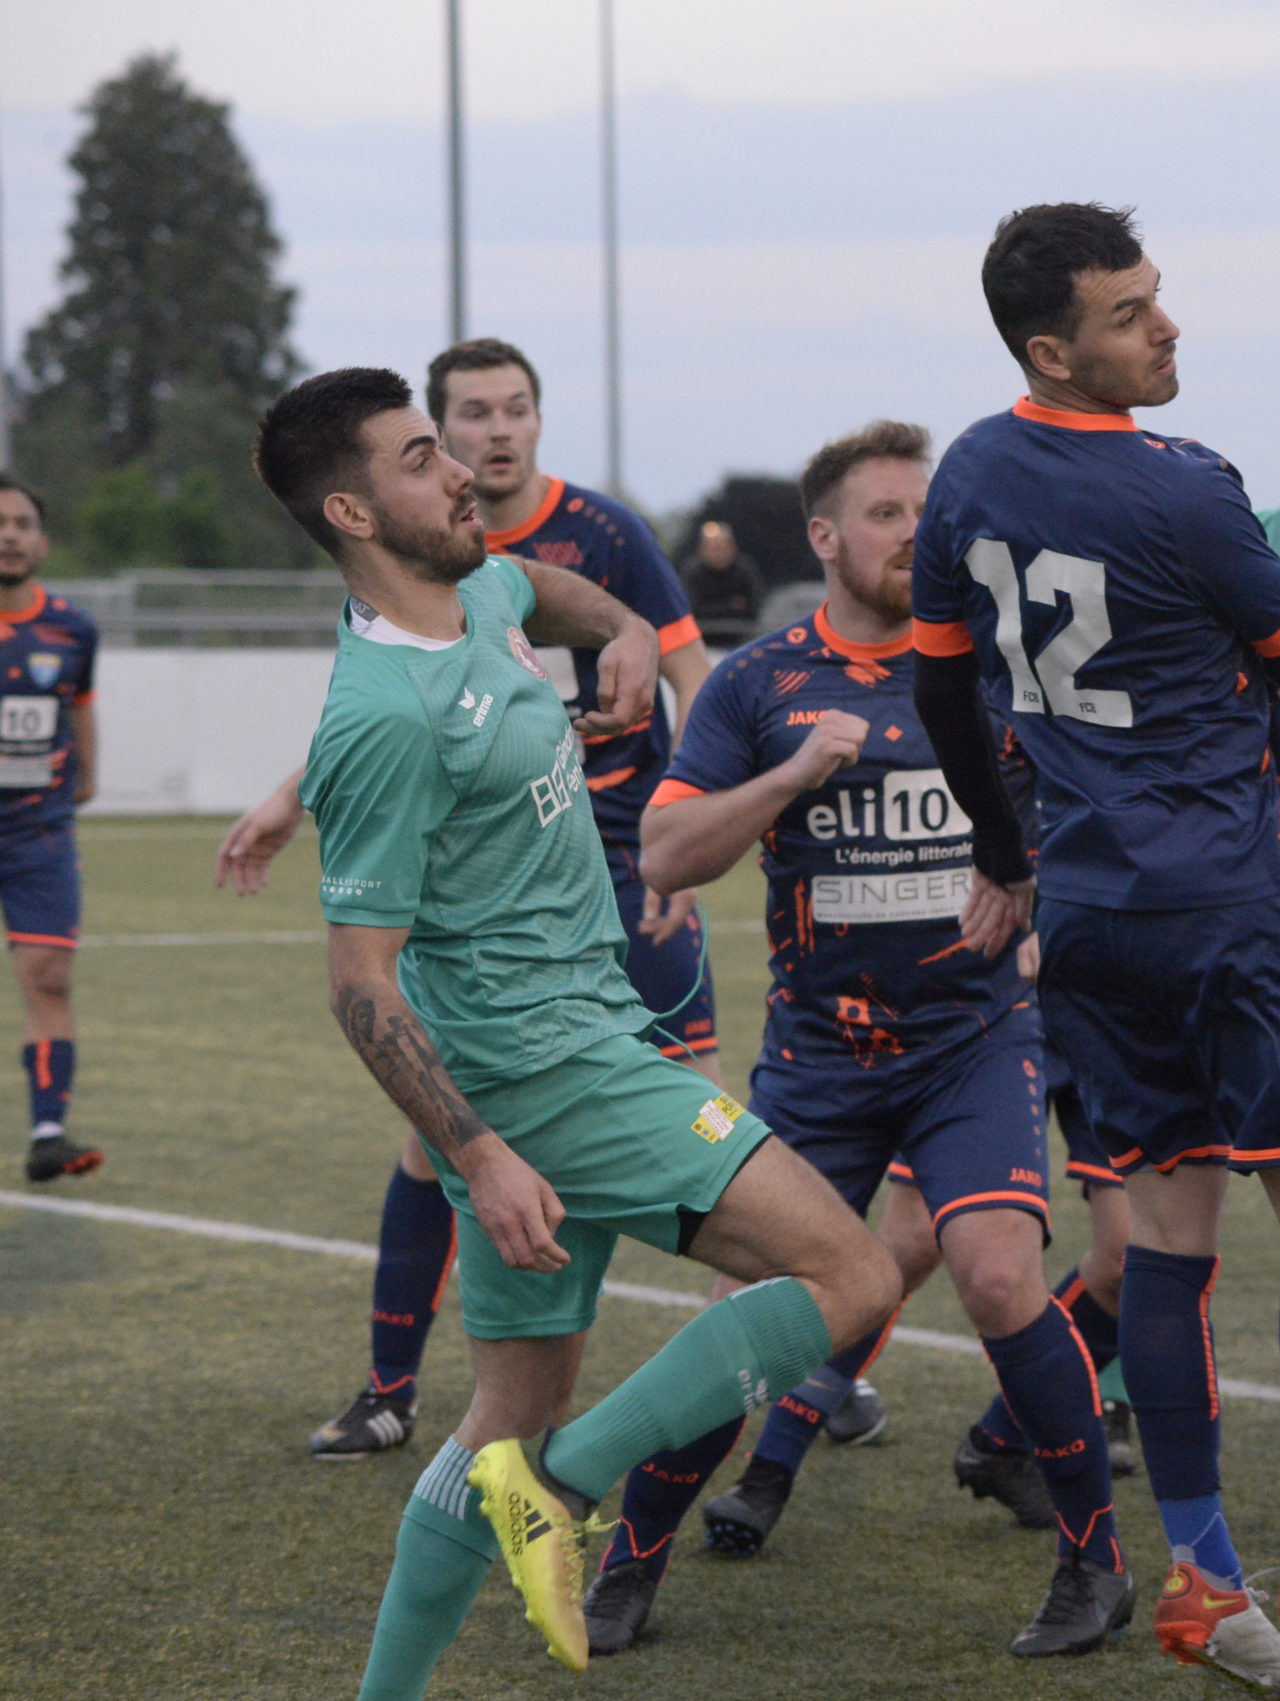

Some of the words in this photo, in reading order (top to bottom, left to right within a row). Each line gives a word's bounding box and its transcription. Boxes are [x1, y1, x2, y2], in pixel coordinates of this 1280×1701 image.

[964, 537, 1134, 728] 12
[472, 693, 494, 728] erima
[807, 787, 949, 840] eli10
[835, 846, 915, 867] L'énergie
[817, 872, 970, 905] SINGER
[1009, 1167, 1042, 1187] JAKO
[508, 1491, 523, 1556] adidas
